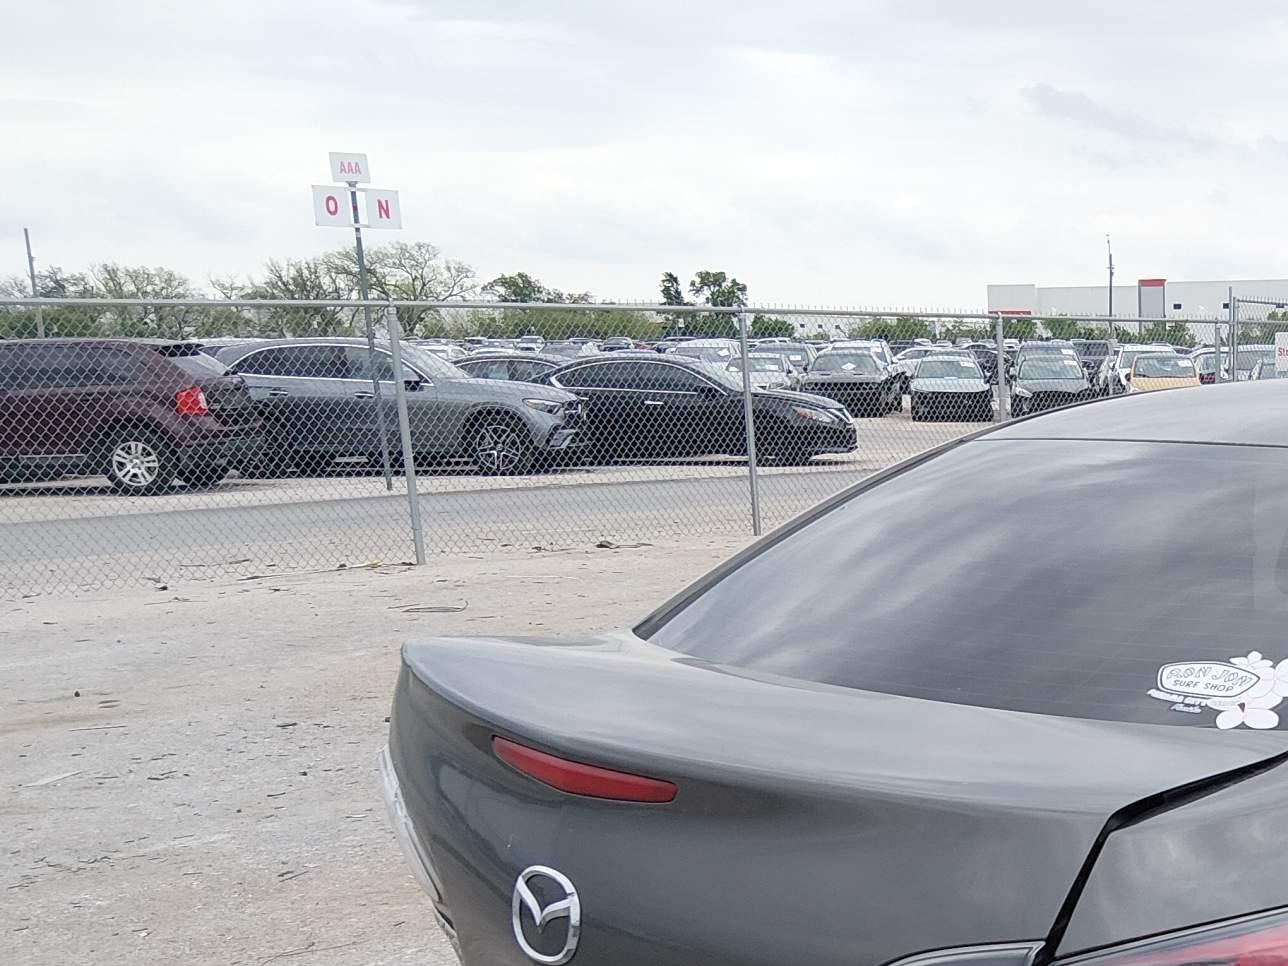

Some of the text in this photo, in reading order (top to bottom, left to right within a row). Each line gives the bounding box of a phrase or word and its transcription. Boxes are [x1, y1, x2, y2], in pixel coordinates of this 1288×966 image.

[339, 161, 362, 175] AAA
[377, 199, 391, 219] N
[1167, 666, 1253, 687] RON JON
[1173, 679, 1234, 693] SURF SHOP
